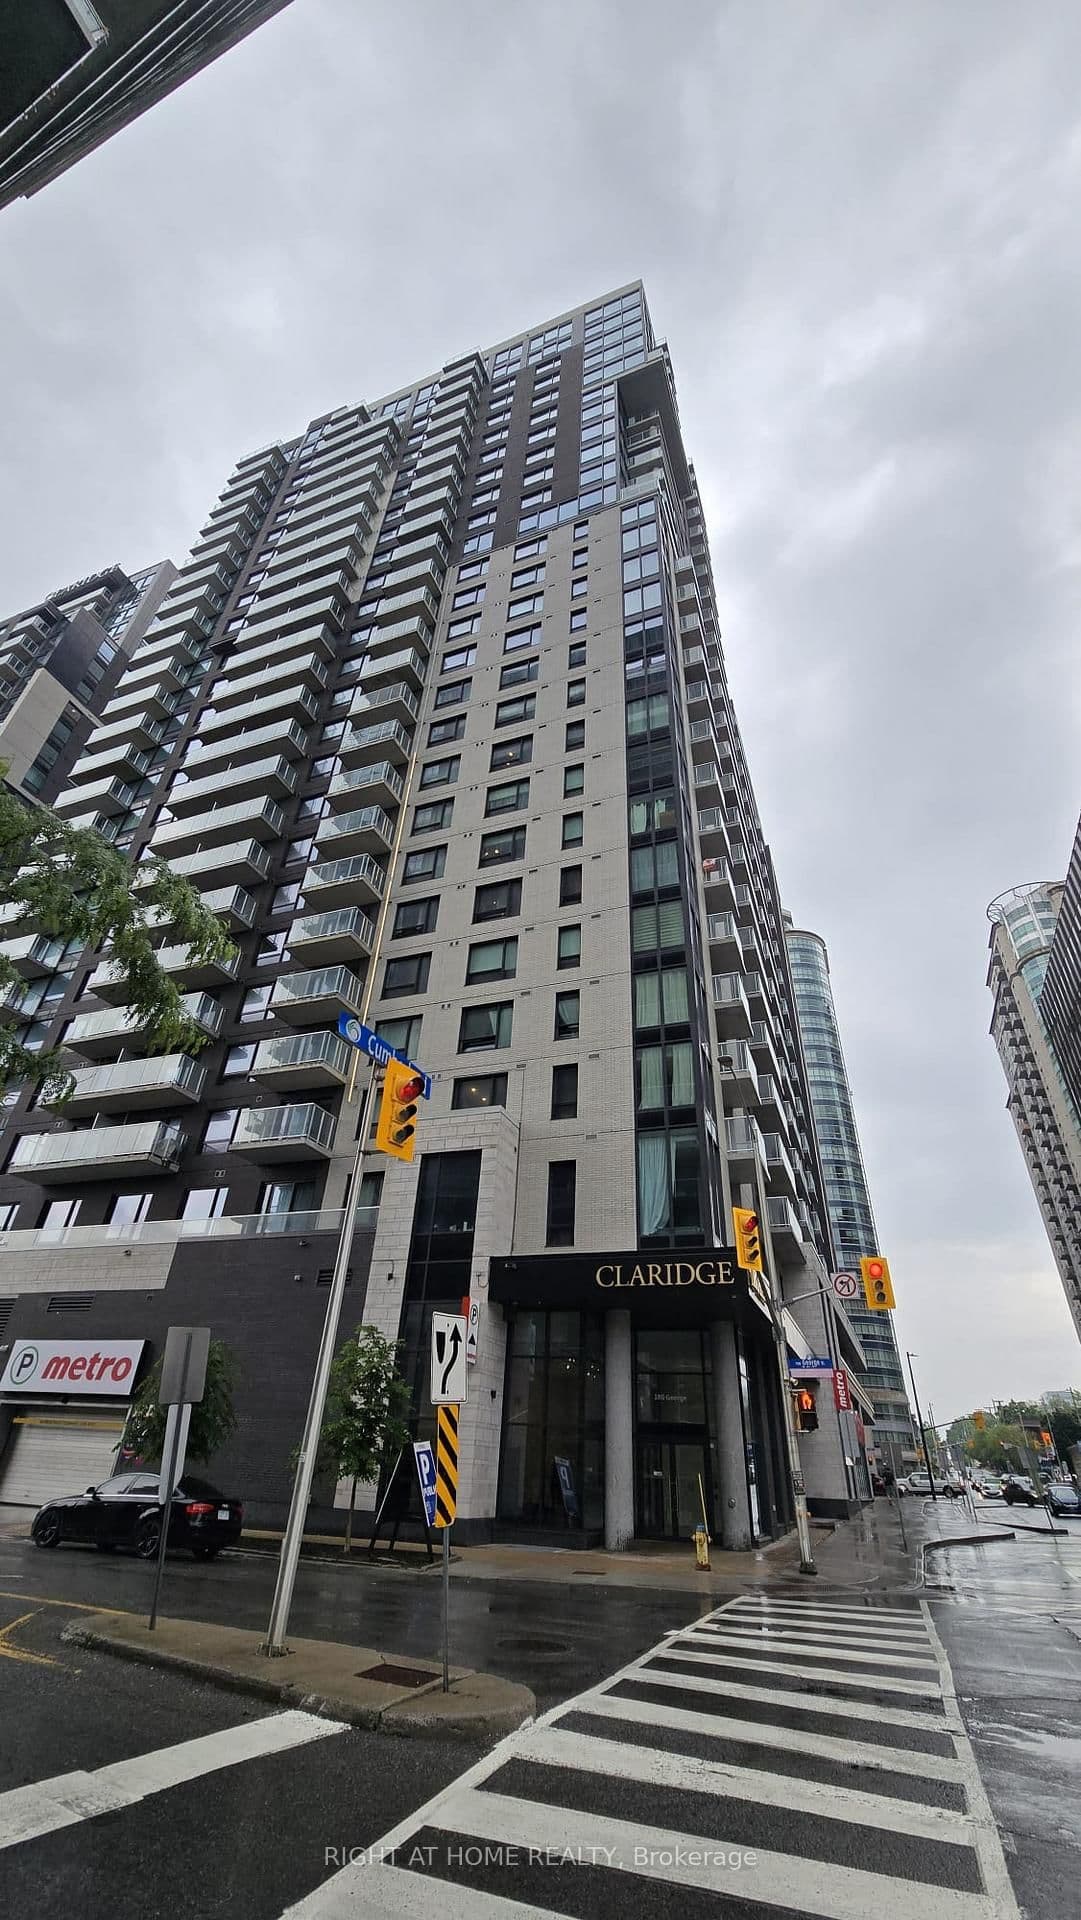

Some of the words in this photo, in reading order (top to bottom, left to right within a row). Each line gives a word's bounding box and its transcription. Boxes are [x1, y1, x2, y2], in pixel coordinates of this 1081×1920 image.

[595, 1261, 735, 1288] CLARIDGE
[16, 1353, 34, 1377] P
[41, 1352, 132, 1382] metro
[836, 1371, 848, 1408] metro
[419, 1453, 430, 1485] P
